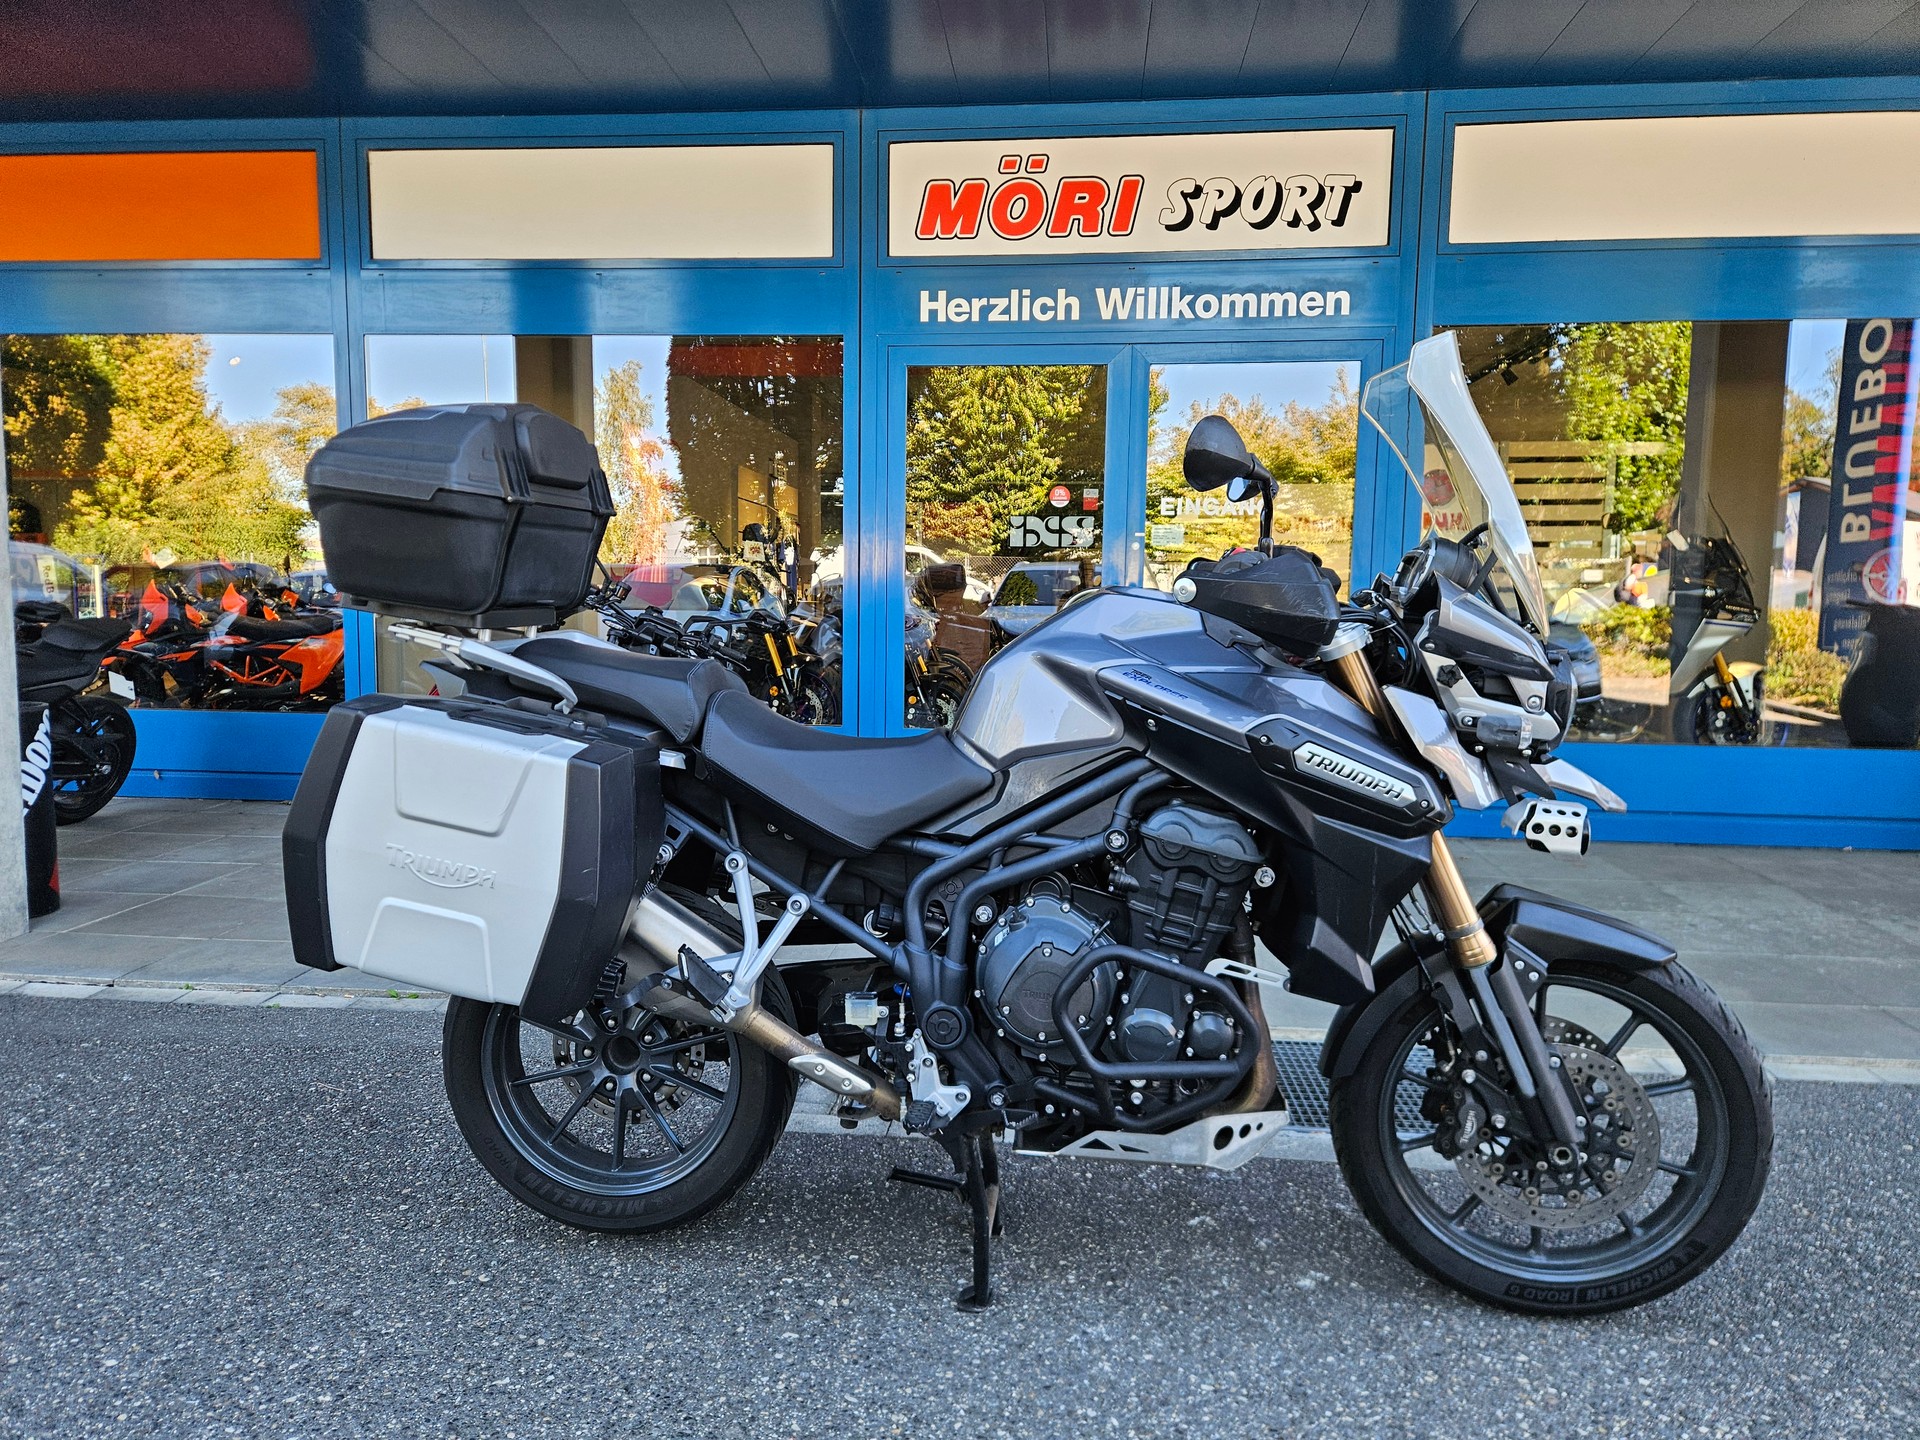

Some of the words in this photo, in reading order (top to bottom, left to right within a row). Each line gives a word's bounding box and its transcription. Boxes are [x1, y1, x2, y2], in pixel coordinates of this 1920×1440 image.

[914, 153, 1145, 240] MÖRI
[1158, 174, 1363, 232] SPORT
[919, 288, 1080, 323] Herzlich
[1095, 286, 1351, 320] Willkommen
[1304, 750, 1406, 800] TRIUMPH
[385, 842, 497, 889] TRIUMPH
[521, 1172, 646, 1216] MICHELIN
[1523, 1287, 1570, 1301] ROAD
[1585, 1258, 1677, 1296] MICHELIN
